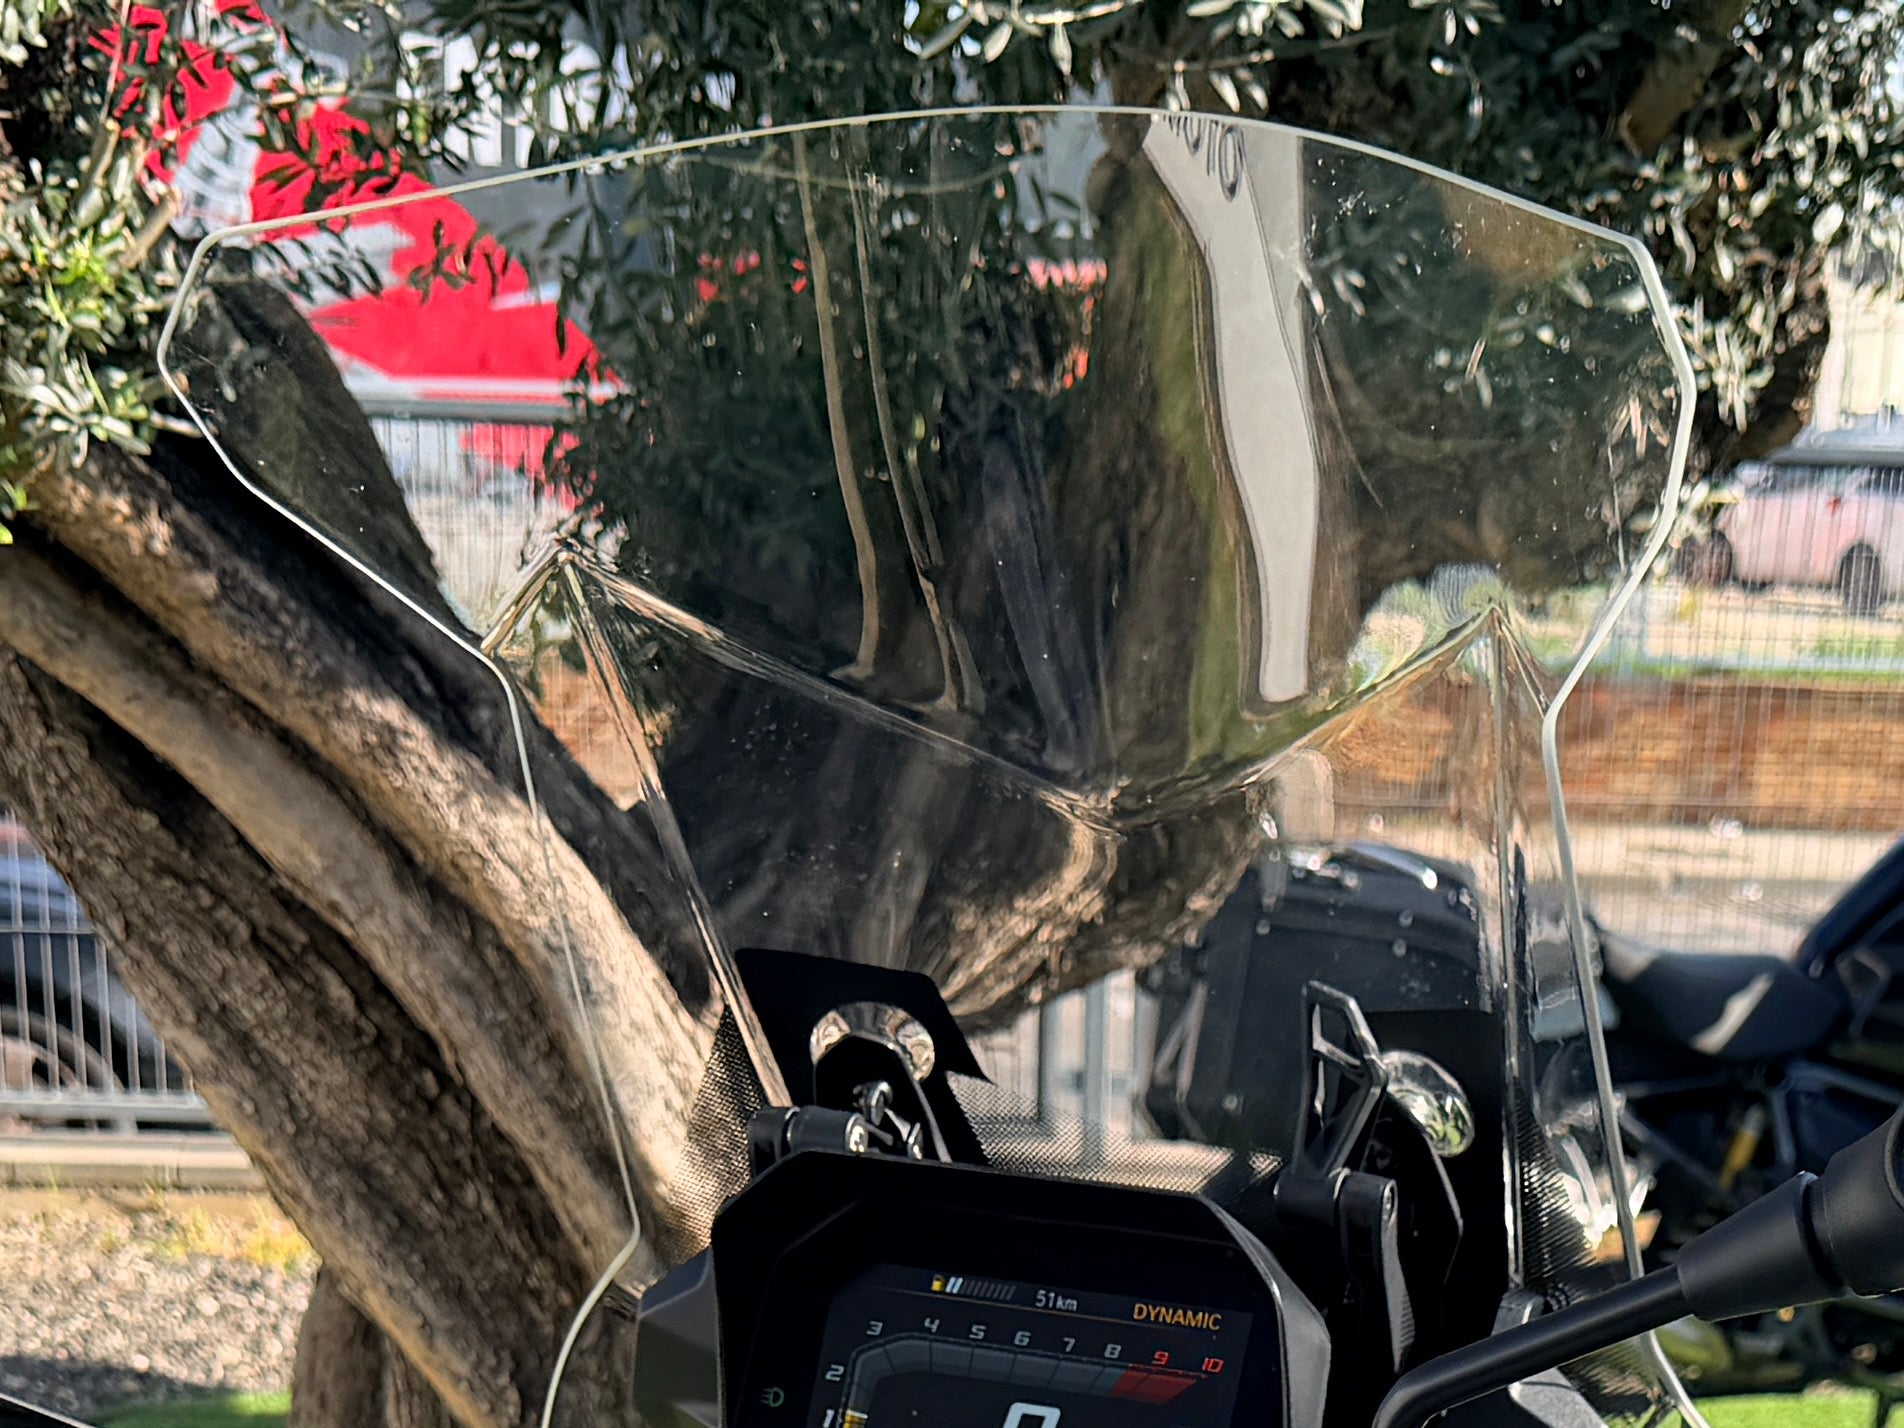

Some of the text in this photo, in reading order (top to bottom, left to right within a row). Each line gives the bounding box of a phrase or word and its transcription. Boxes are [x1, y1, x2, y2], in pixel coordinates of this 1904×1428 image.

[1132, 1302, 1222, 1331] DYNAMIC
[866, 1317, 1225, 1373] 3 4 5 6 7 8 9 10
[825, 1364, 845, 1382] 2
[822, 1409, 835, 1428] 1
